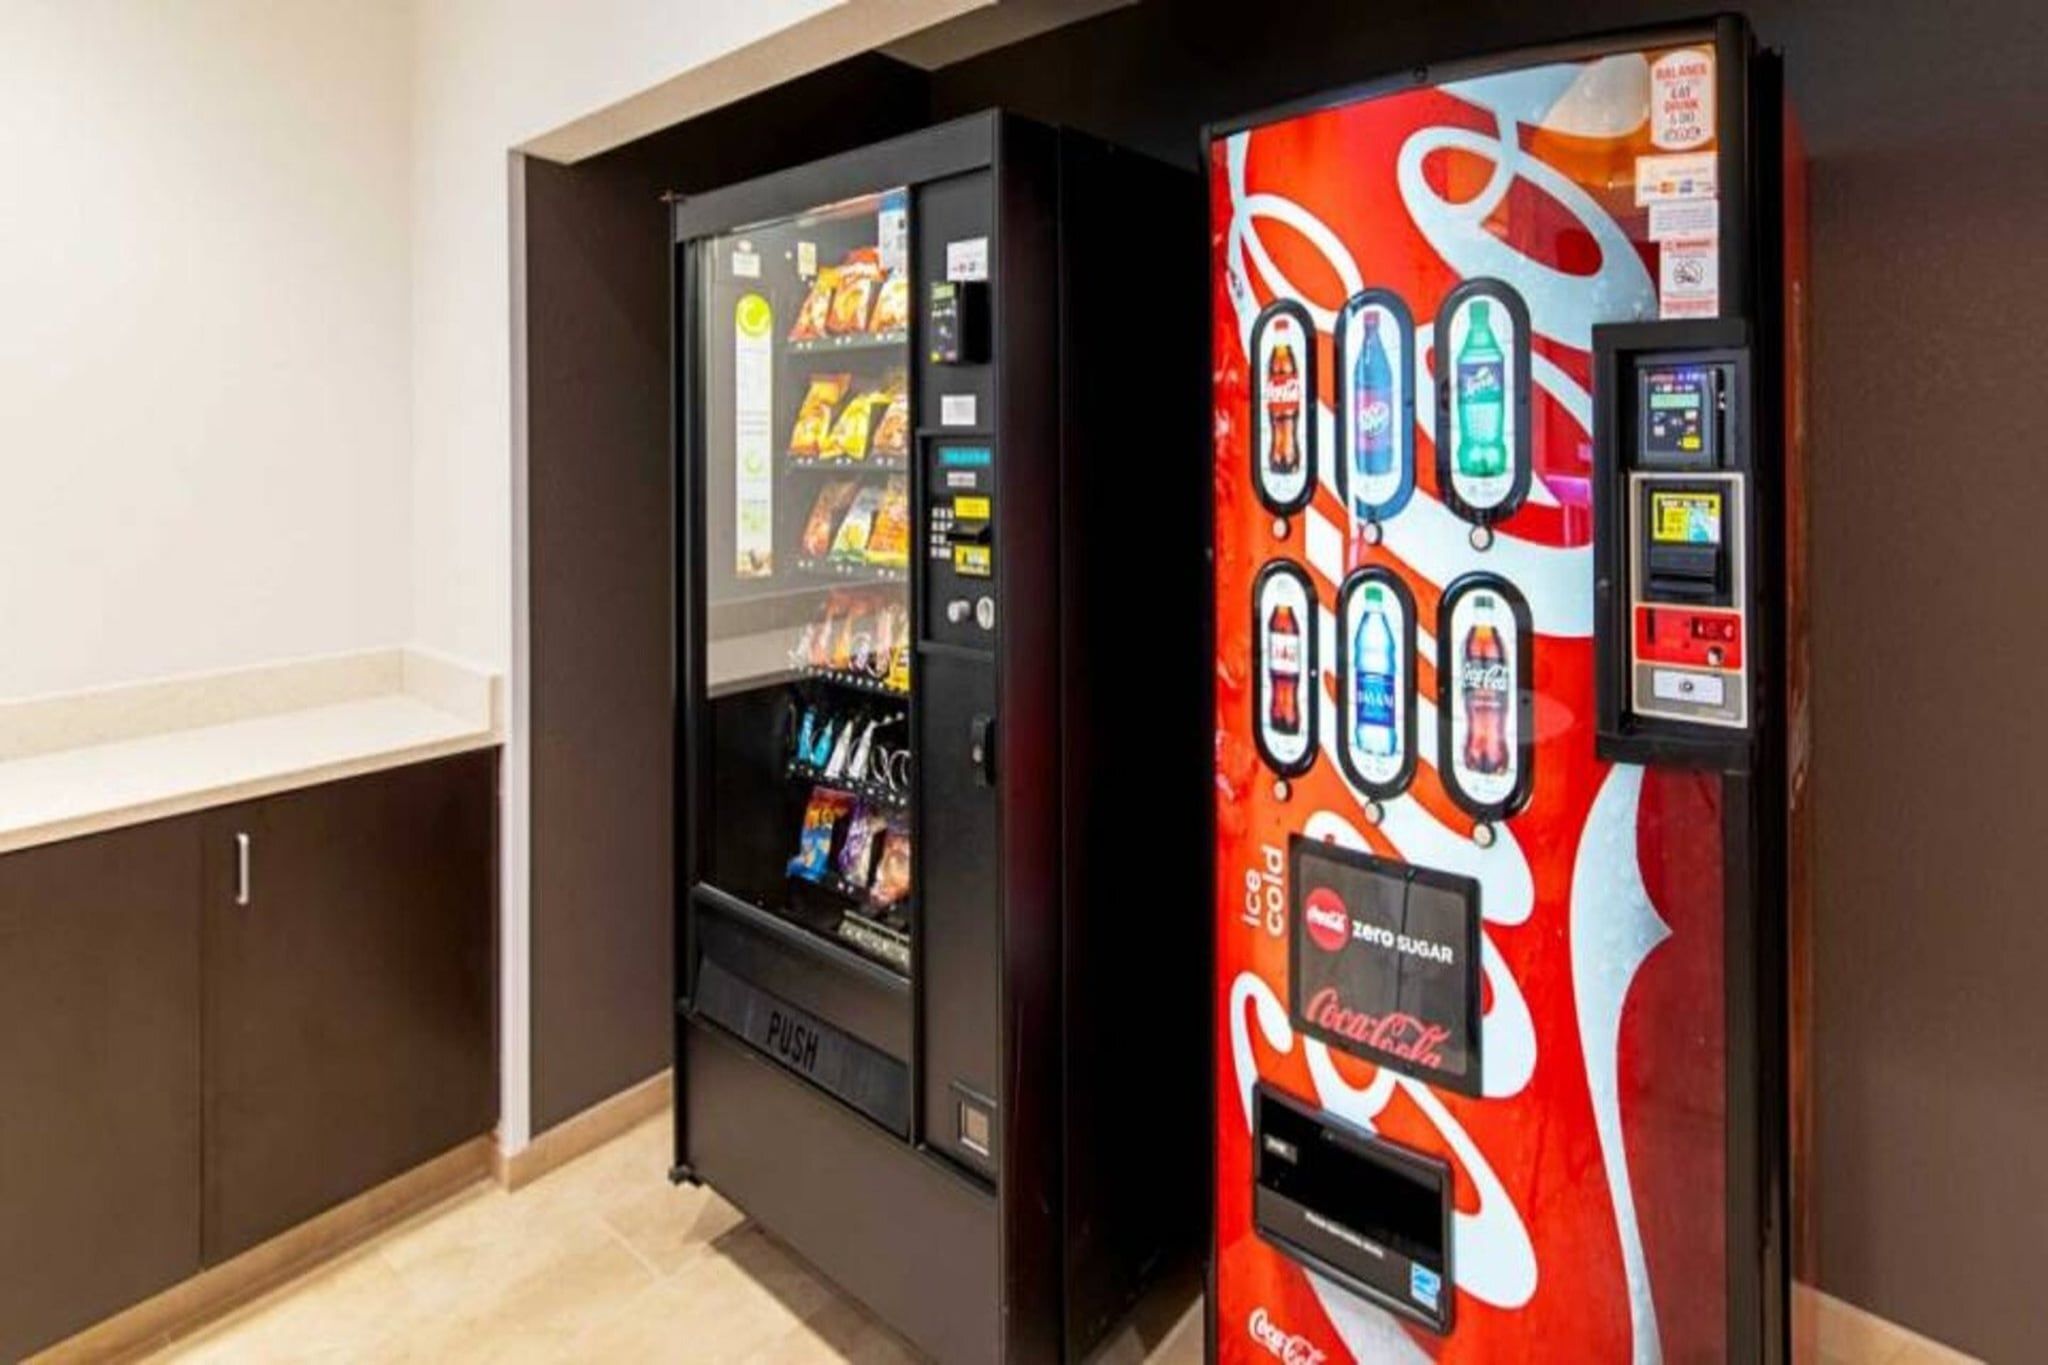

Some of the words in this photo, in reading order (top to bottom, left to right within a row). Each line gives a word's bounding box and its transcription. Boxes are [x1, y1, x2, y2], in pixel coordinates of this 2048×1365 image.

[1242, 869, 1262, 927] ice
[1262, 845, 1284, 936] cold
[1352, 920, 1394, 948] zero
[1397, 935, 1453, 964] SUGAR
[767, 1010, 819, 1073] PUSH
